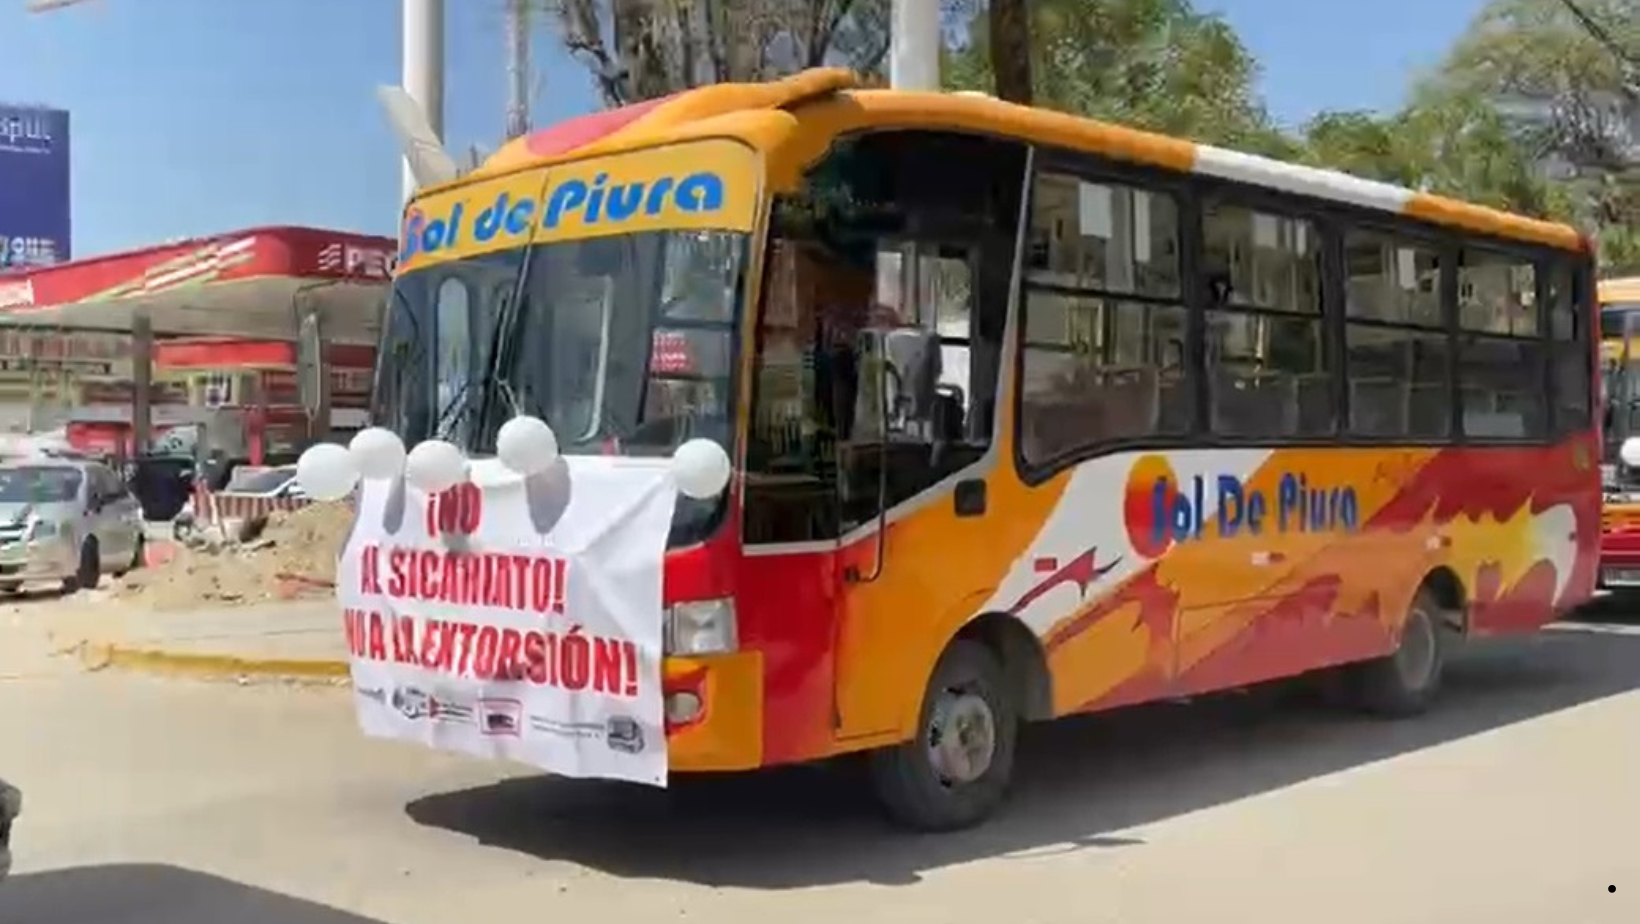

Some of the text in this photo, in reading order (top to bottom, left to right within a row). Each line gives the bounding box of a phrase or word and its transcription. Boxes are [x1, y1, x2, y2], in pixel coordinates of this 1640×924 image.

[401, 172, 724, 262] Sol de Piura
[1152, 471, 1359, 545] Sol De Piura
[370, 611, 387, 661] A
[421, 619, 638, 697] EXTORSIÓN!
